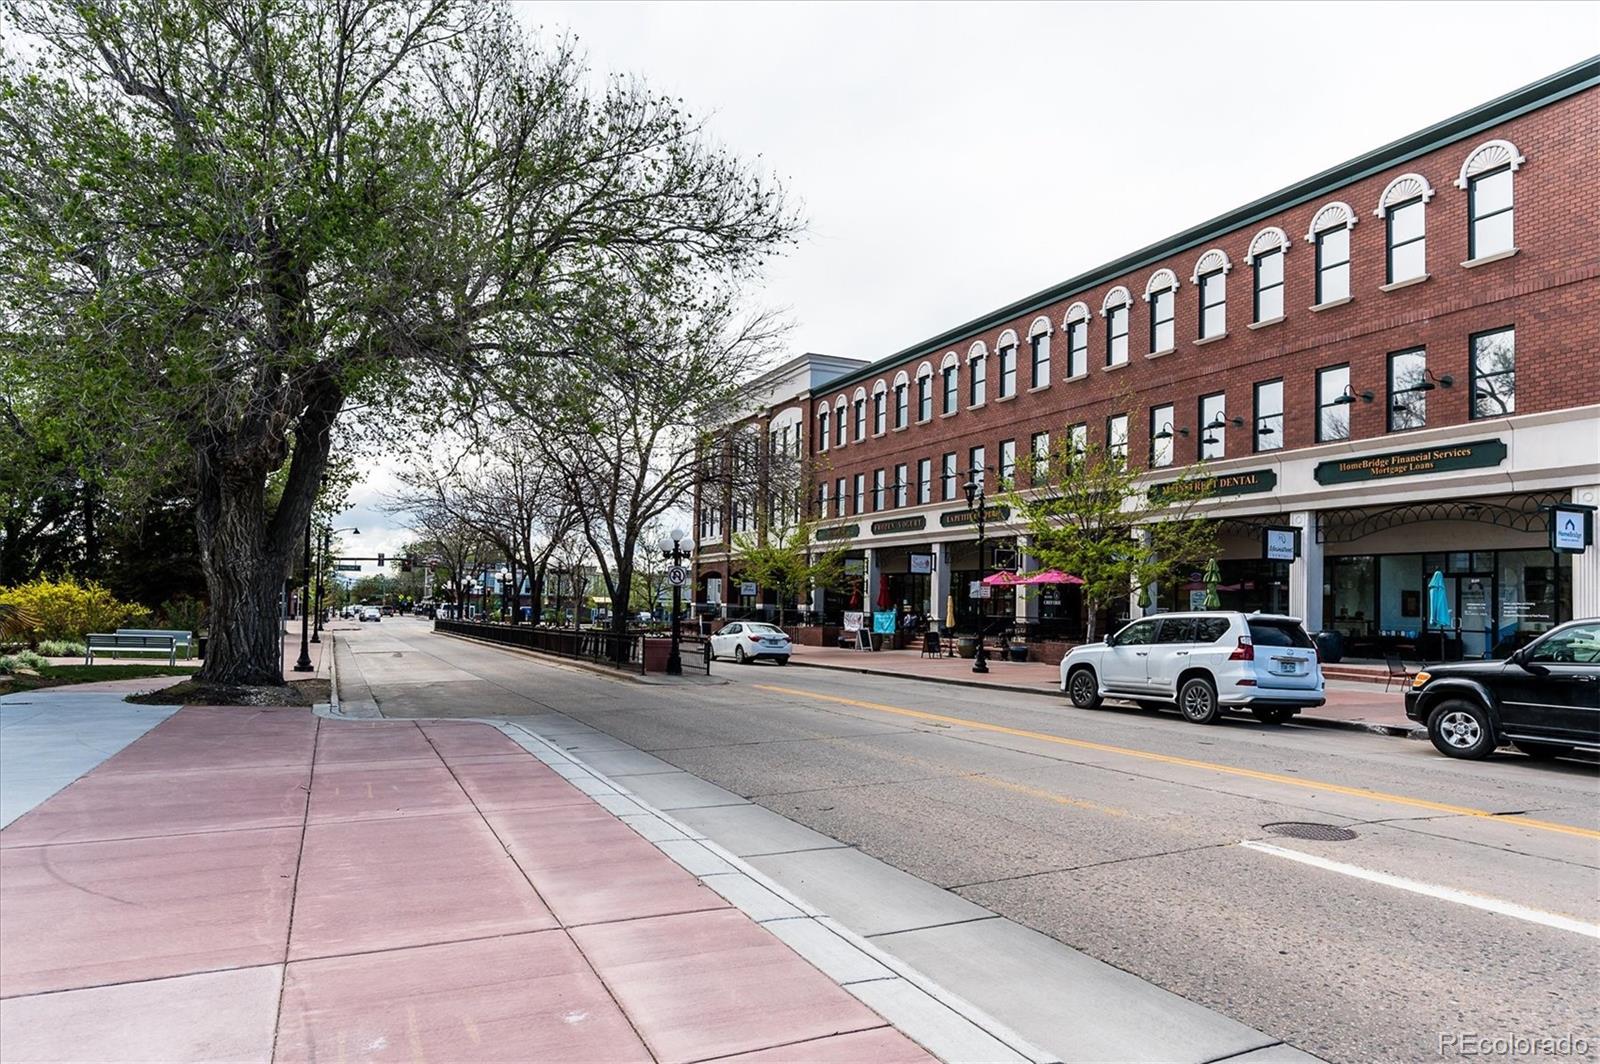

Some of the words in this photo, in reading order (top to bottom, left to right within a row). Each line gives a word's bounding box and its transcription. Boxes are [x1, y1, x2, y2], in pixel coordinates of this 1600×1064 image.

[1339, 458, 1389, 472] HomeBridge
[1391, 452, 1431, 465] Financial
[1433, 447, 1472, 460] Services
[1371, 464, 1407, 475] Mortgage
[1409, 461, 1434, 471] Loans
[1220, 475, 1258, 488] DENTAL
